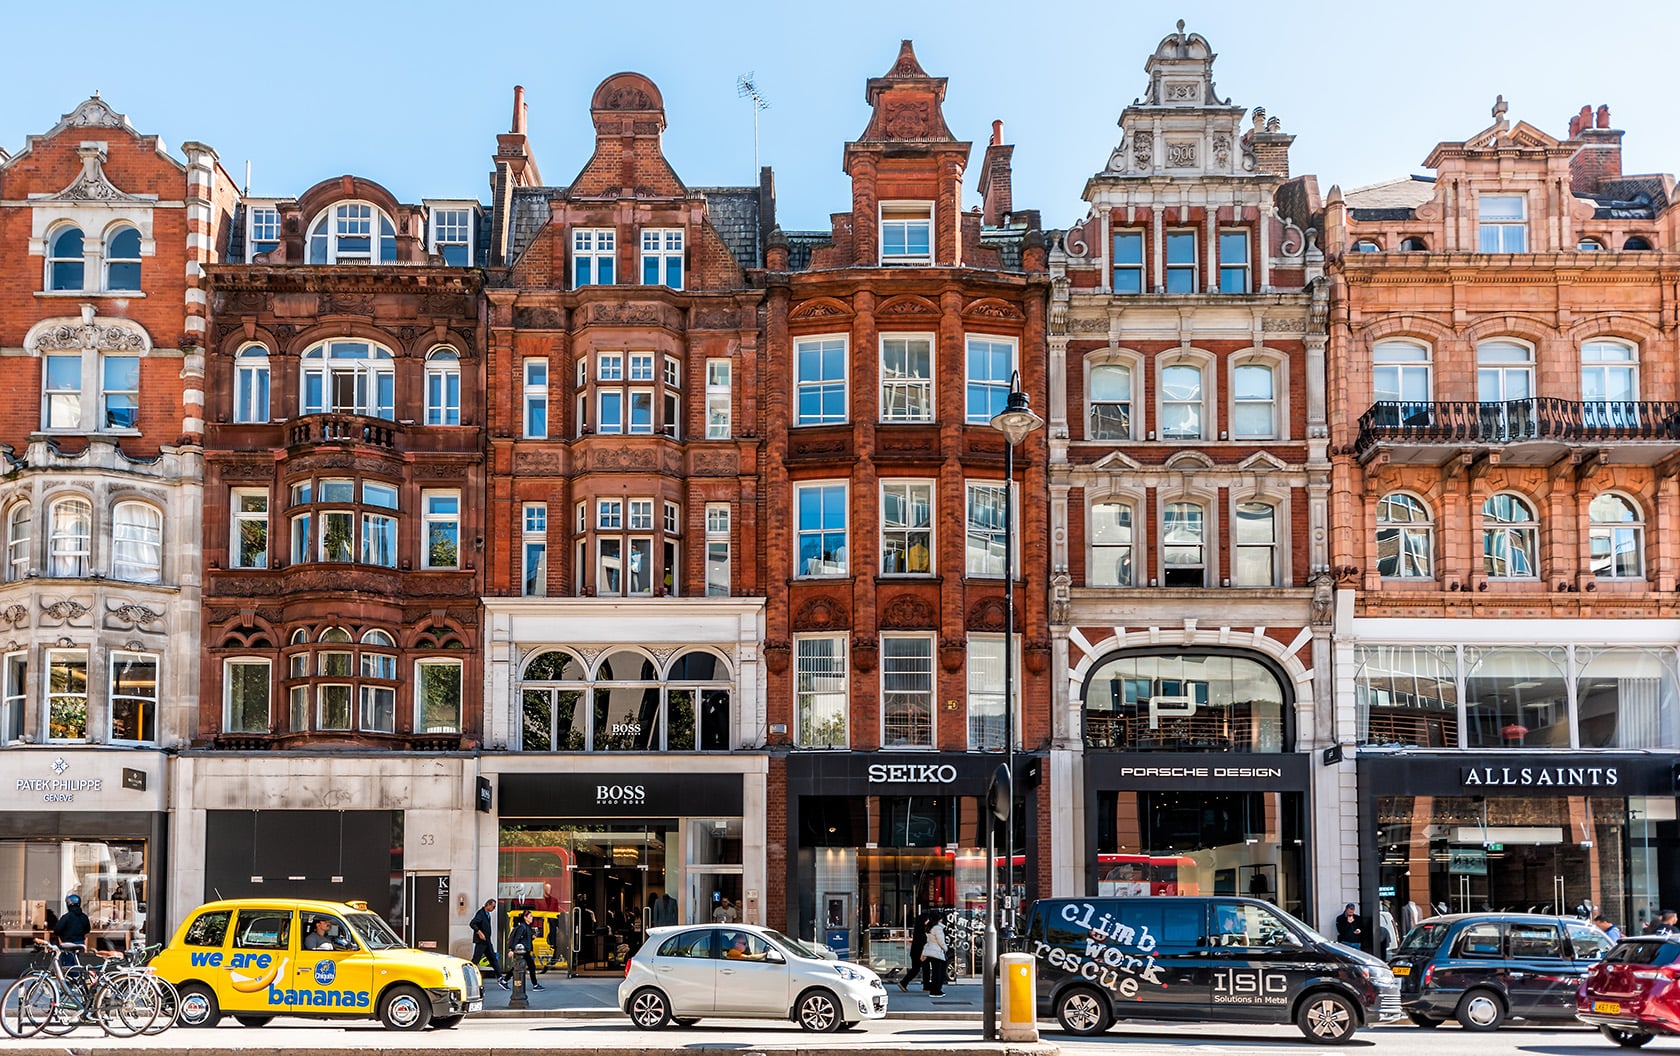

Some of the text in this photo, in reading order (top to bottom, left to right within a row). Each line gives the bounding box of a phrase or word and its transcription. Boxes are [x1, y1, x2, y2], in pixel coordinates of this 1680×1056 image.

[1168, 147, 1196, 162] 1900
[612, 723, 641, 733] BOSS
[868, 764, 957, 783] SEIKO
[1121, 768, 1281, 777] PORSCHE DESIGN
[1465, 768, 1618, 785] ALLSAINTS
[16, 779, 102, 791] PATEK PHILIPPE
[596, 785, 645, 800] BOSS
[421, 834, 434, 845] 53
[438, 877, 448, 888] K
[191, 952, 272, 969] we are
[268, 983, 370, 1008] bananas
[1214, 995, 1288, 1004] Solutions in Metal
